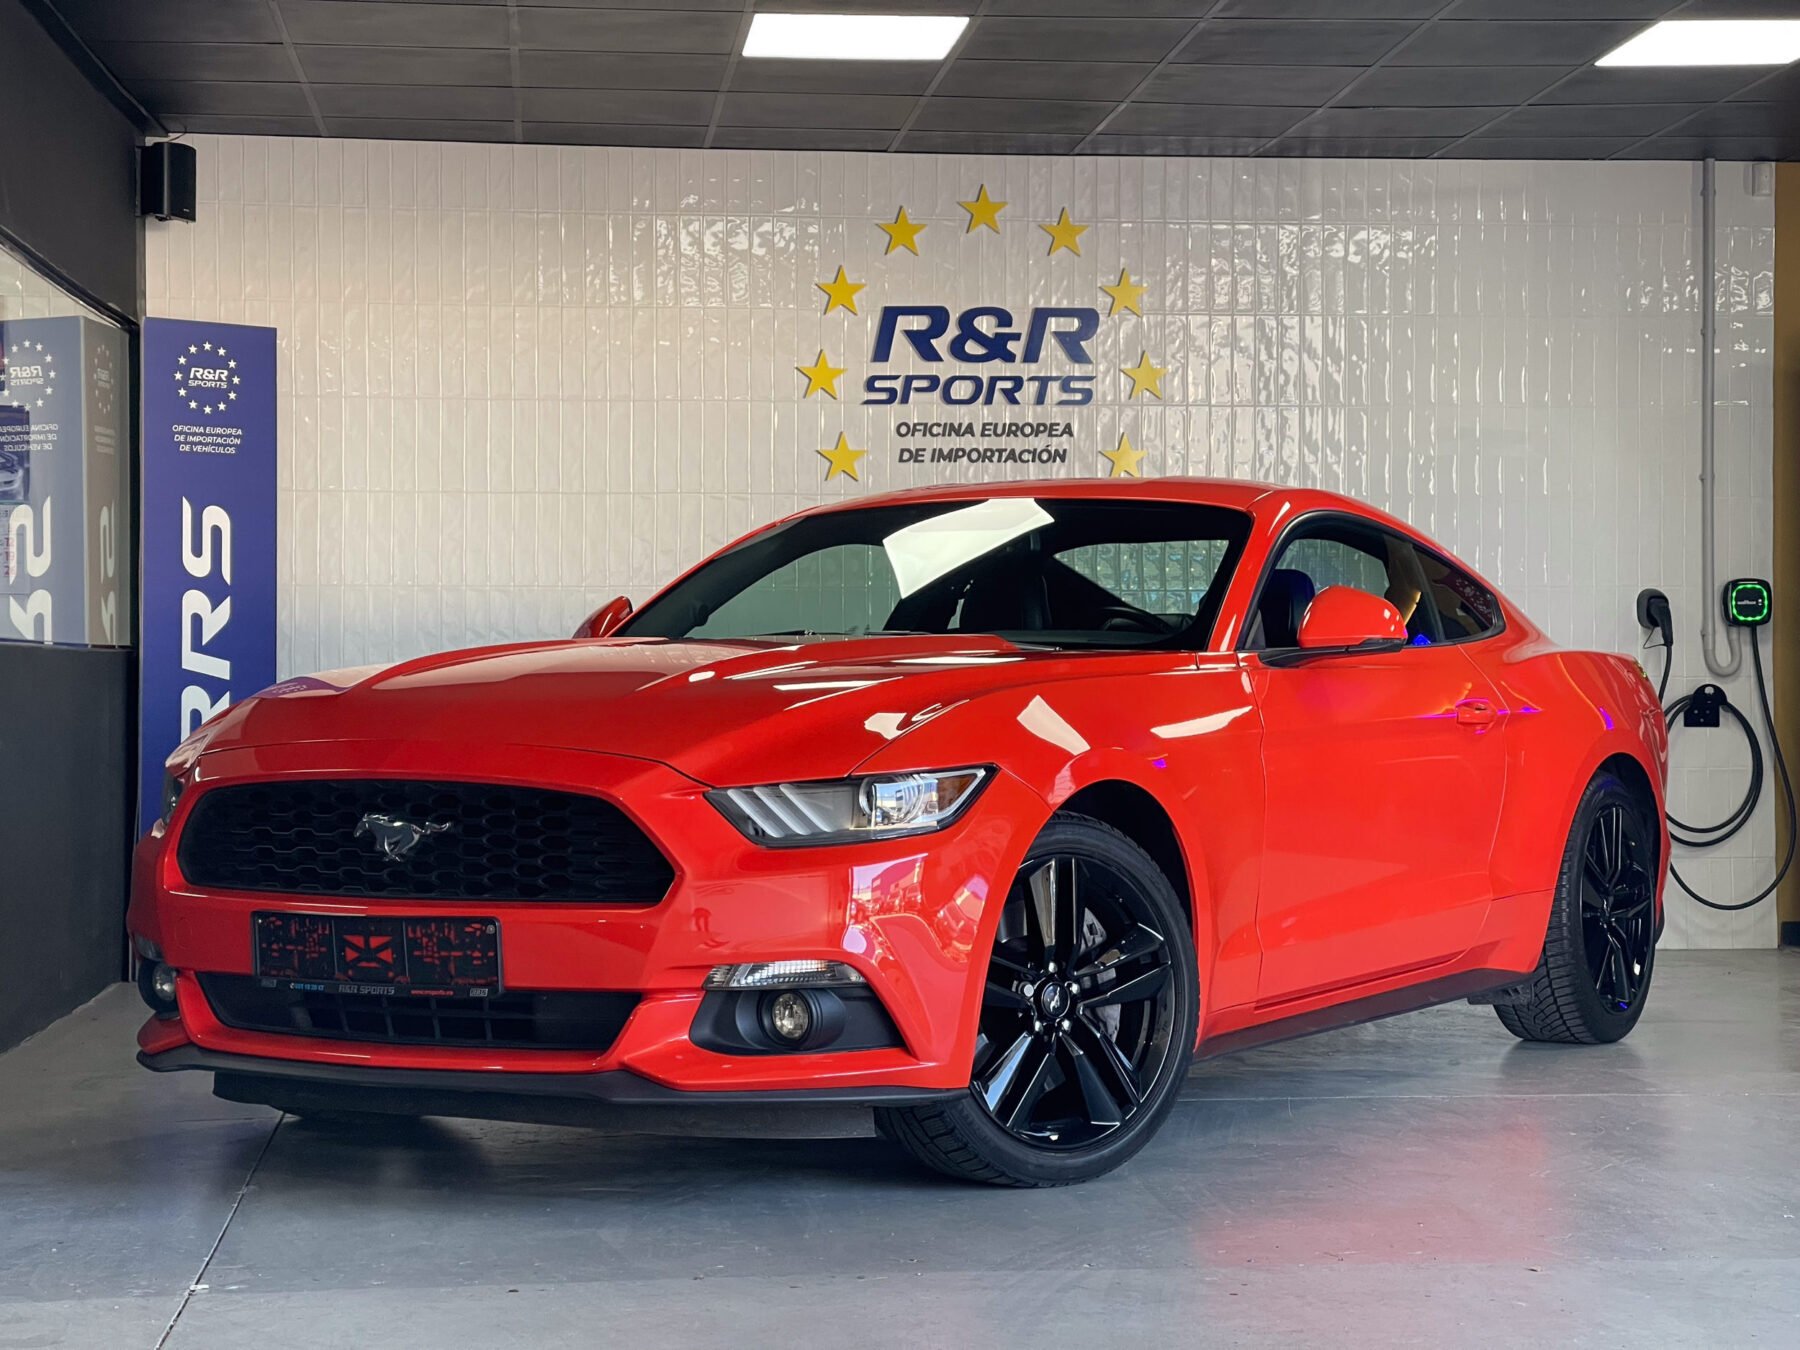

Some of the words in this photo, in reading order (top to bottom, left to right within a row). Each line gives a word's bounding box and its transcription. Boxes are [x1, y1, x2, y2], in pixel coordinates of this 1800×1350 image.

[870, 305, 1100, 364] R&R
[190, 367, 228, 381] R&R
[188, 380, 228, 389] SPORTS
[860, 374, 1097, 406] SPORTS
[172, 424, 205, 434] OFICINA
[206, 427, 242, 436] EUROPEA
[895, 421, 976, 438] OFICINA
[980, 421, 1074, 438] EUROPEA
[174, 434, 186, 442] DE
[187, 434, 241, 445] IMPORTACIÓN
[179, 444, 191, 452] DE
[192, 444, 236, 454] VEHÍCULOS
[898, 447, 926, 463] DE
[930, 444, 1067, 464] IMPORTACIÓN
[359, 985, 395, 996] SPORTS
